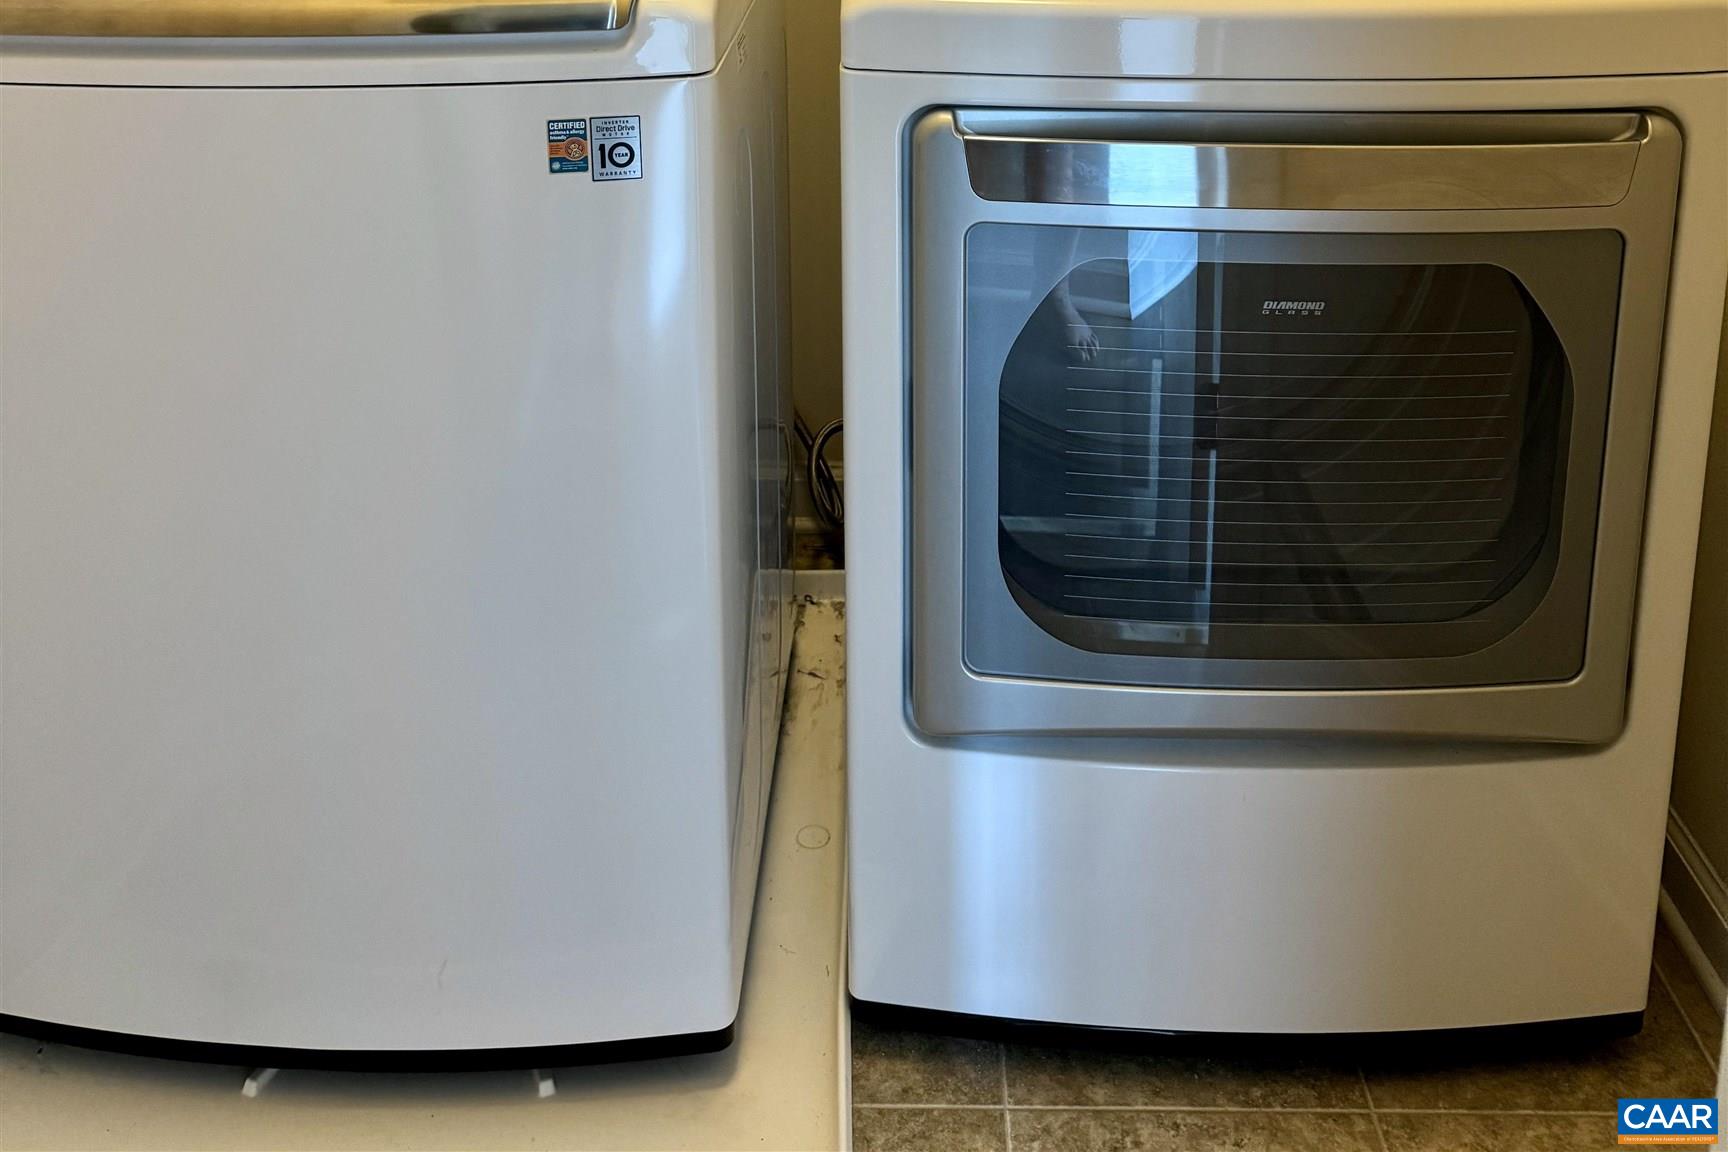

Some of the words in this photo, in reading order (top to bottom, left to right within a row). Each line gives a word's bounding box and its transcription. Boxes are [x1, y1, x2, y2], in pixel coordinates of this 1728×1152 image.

[549, 121, 585, 130] CERTIFIED
[599, 142, 635, 169] 10
[1263, 301, 1325, 310] DIAMOND
